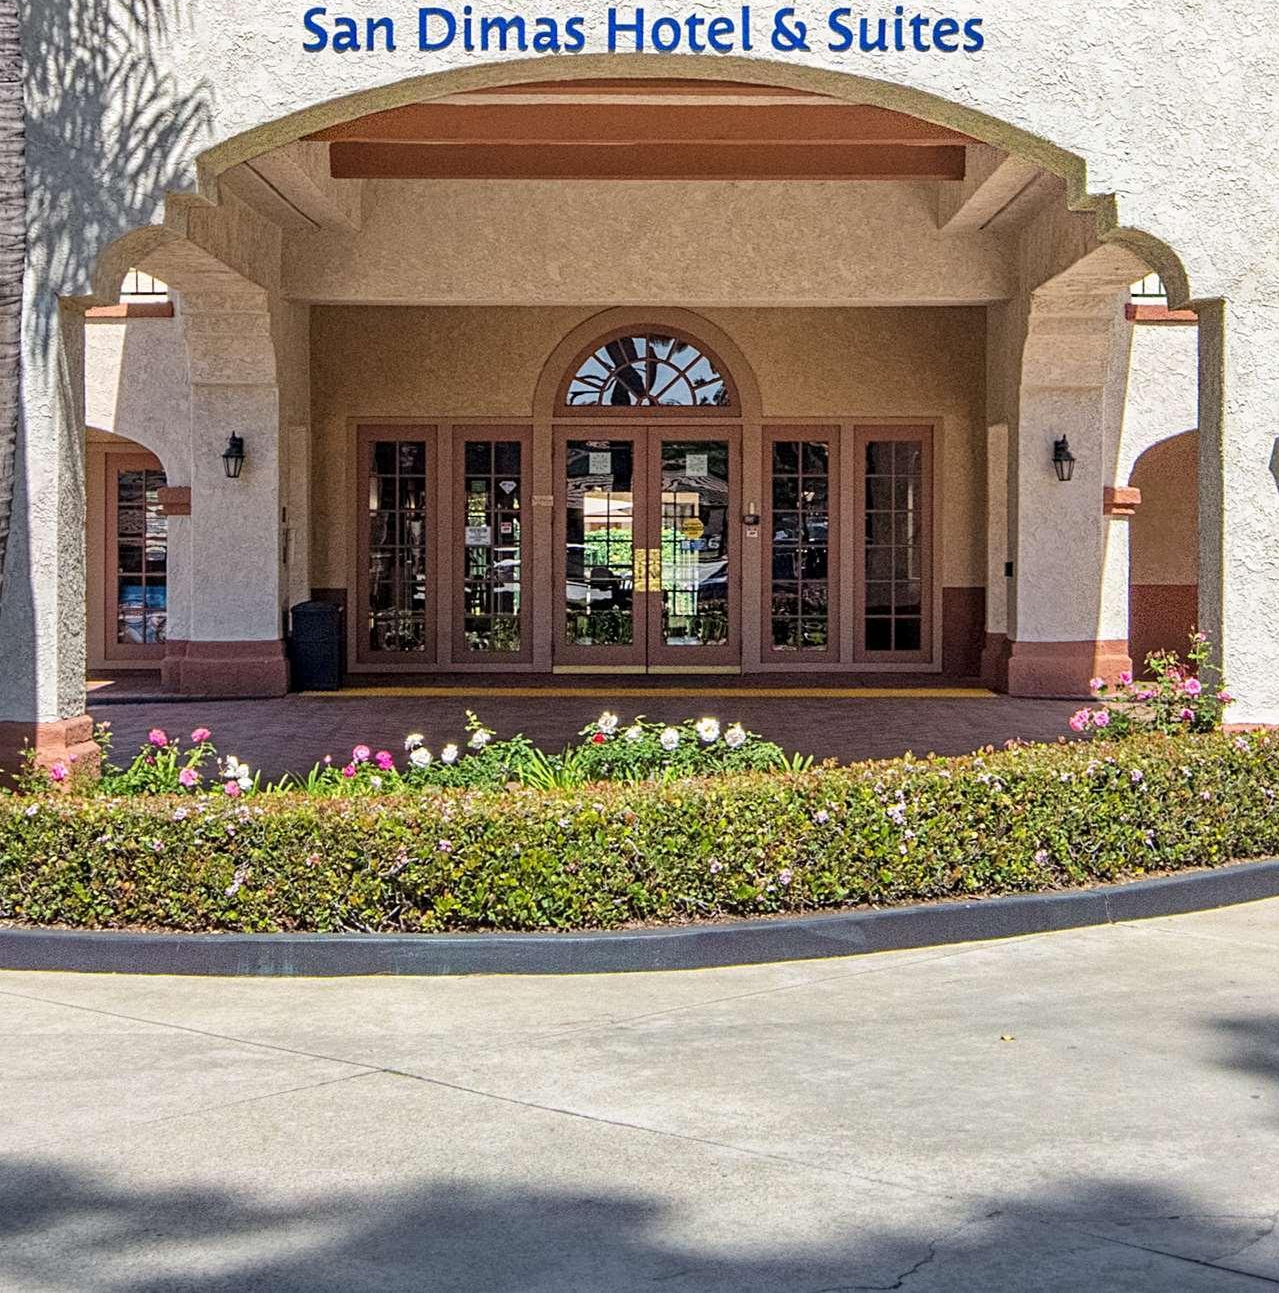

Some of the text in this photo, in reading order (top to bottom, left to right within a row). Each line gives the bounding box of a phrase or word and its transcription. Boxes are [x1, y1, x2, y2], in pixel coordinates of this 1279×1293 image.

[303, 5, 984, 51] San Dimas Hotel & Suites
